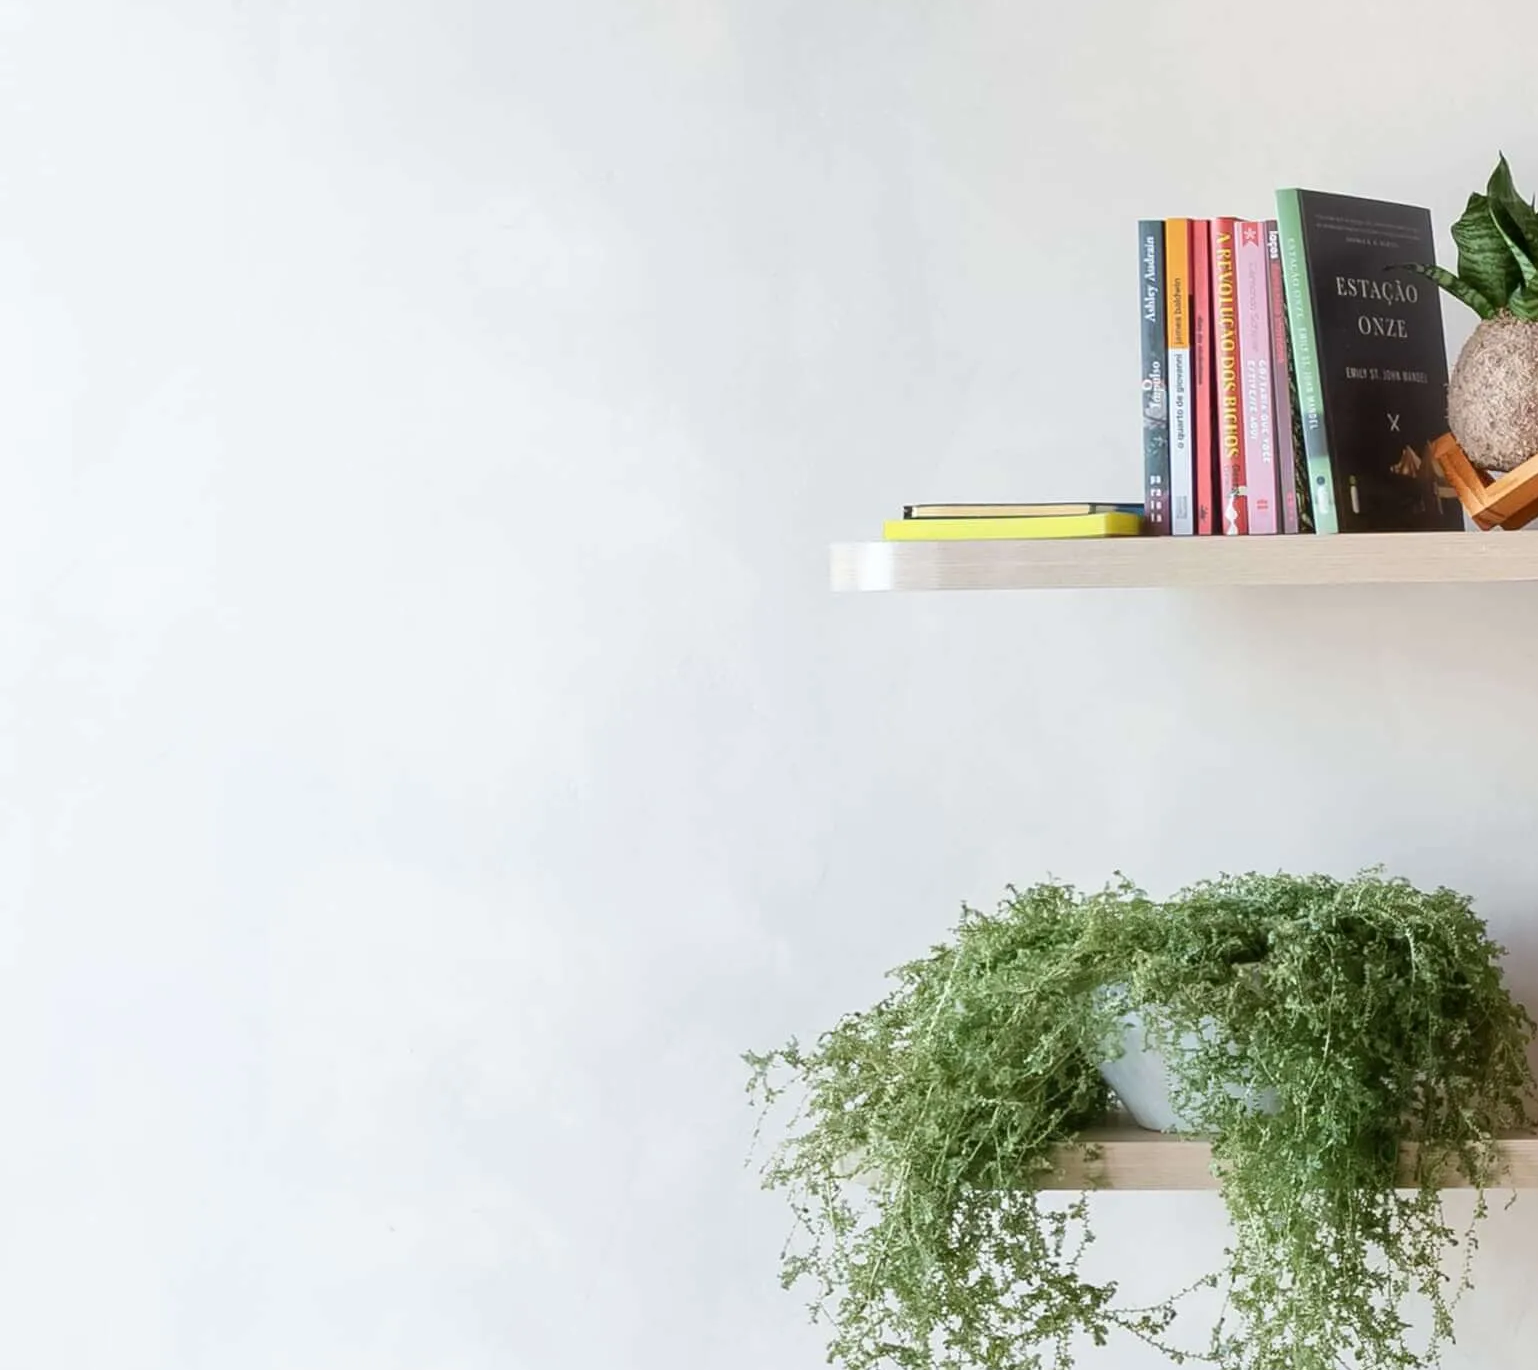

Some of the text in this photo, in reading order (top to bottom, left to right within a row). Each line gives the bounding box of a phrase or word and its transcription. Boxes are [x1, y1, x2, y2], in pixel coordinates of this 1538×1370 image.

[1216, 232, 1231, 244] A
[1267, 231, 1279, 259] laços
[1143, 236, 1158, 323] Ashley Audrain
[1335, 276, 1419, 306] ESTAÇÃO
[1172, 277, 1184, 345] james baldwin
[1217, 248, 1236, 351] REVOLUÇÃO
[1358, 315, 1408, 338] ONZE
[1142, 379, 1153, 391] O
[1150, 361, 1166, 410] Impulso
[1174, 353, 1185, 393] giovanni
[1221, 356, 1236, 391] DOS
[1346, 366, 1367, 380] EMILY
[1383, 368, 1401, 381] JOHN
[1402, 370, 1428, 384] MANDEL
[1174, 394, 1184, 406] de
[1174, 408, 1186, 440] quarto
[1223, 398, 1240, 459] BICHOS
